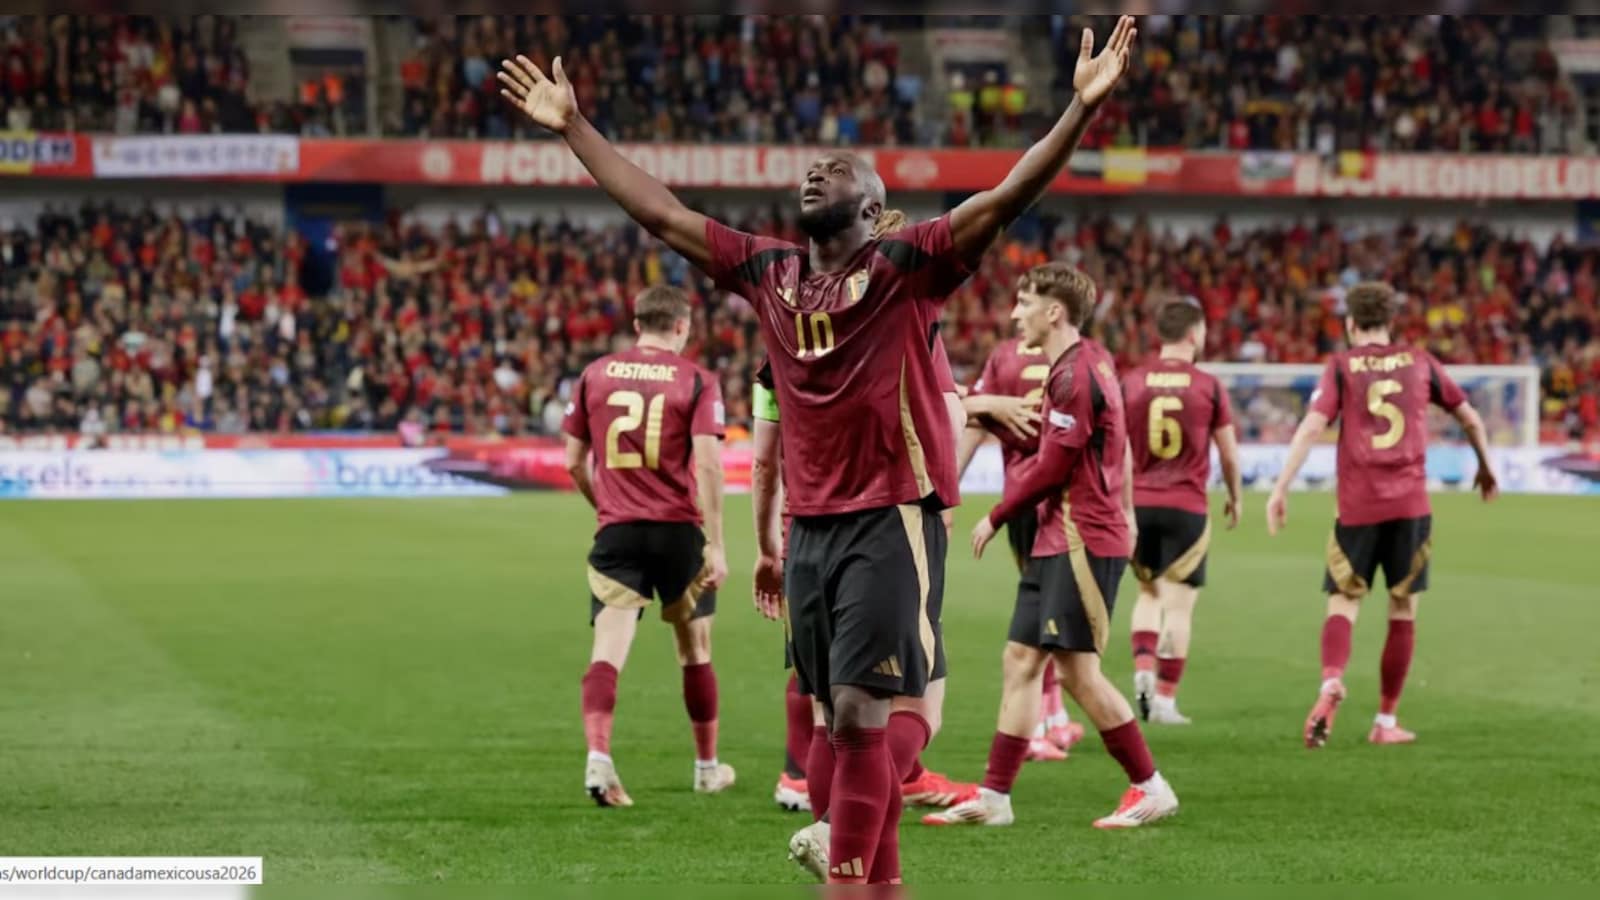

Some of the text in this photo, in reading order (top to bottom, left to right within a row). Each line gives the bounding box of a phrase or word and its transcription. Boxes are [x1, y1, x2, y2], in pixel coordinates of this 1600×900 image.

[795, 311, 834, 358] 10
[605, 360, 678, 382] CASTAGNE
[606, 390, 665, 469] 21
[1149, 396, 1183, 460] 6
[1367, 379, 1405, 449] 5
